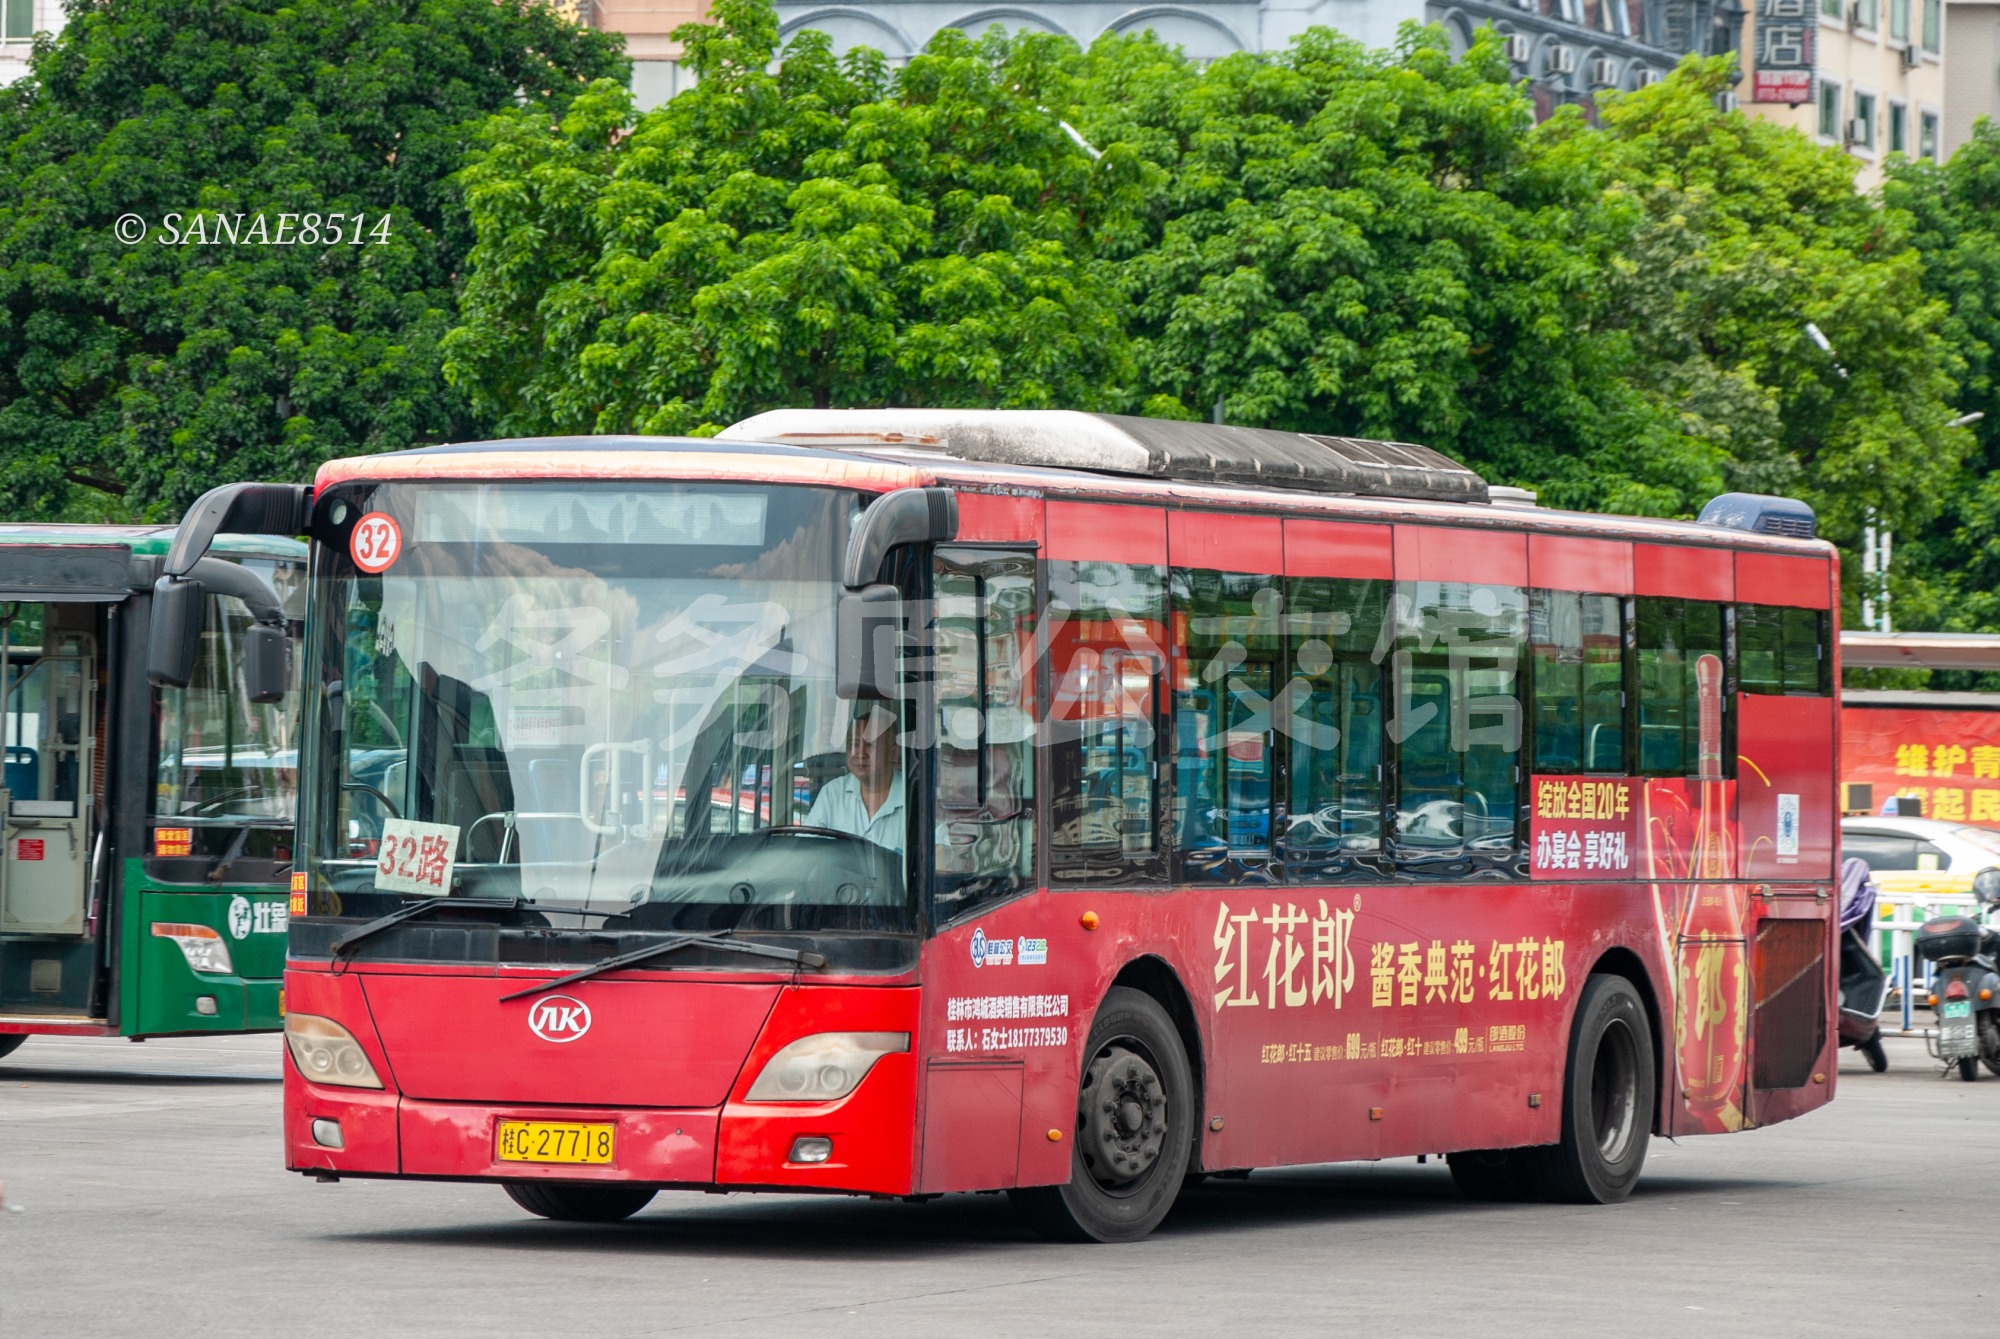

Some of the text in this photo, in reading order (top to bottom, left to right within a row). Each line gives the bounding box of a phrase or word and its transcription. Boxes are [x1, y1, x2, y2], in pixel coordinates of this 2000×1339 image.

[360, 523, 390, 560] 32
[1895, 744, 2000, 779] 维护青
[1538, 780, 1630, 821] 绽放全国20年
[380, 834, 449, 888] 32路
[1537, 830, 1629, 870] 办宴会 享好礼
